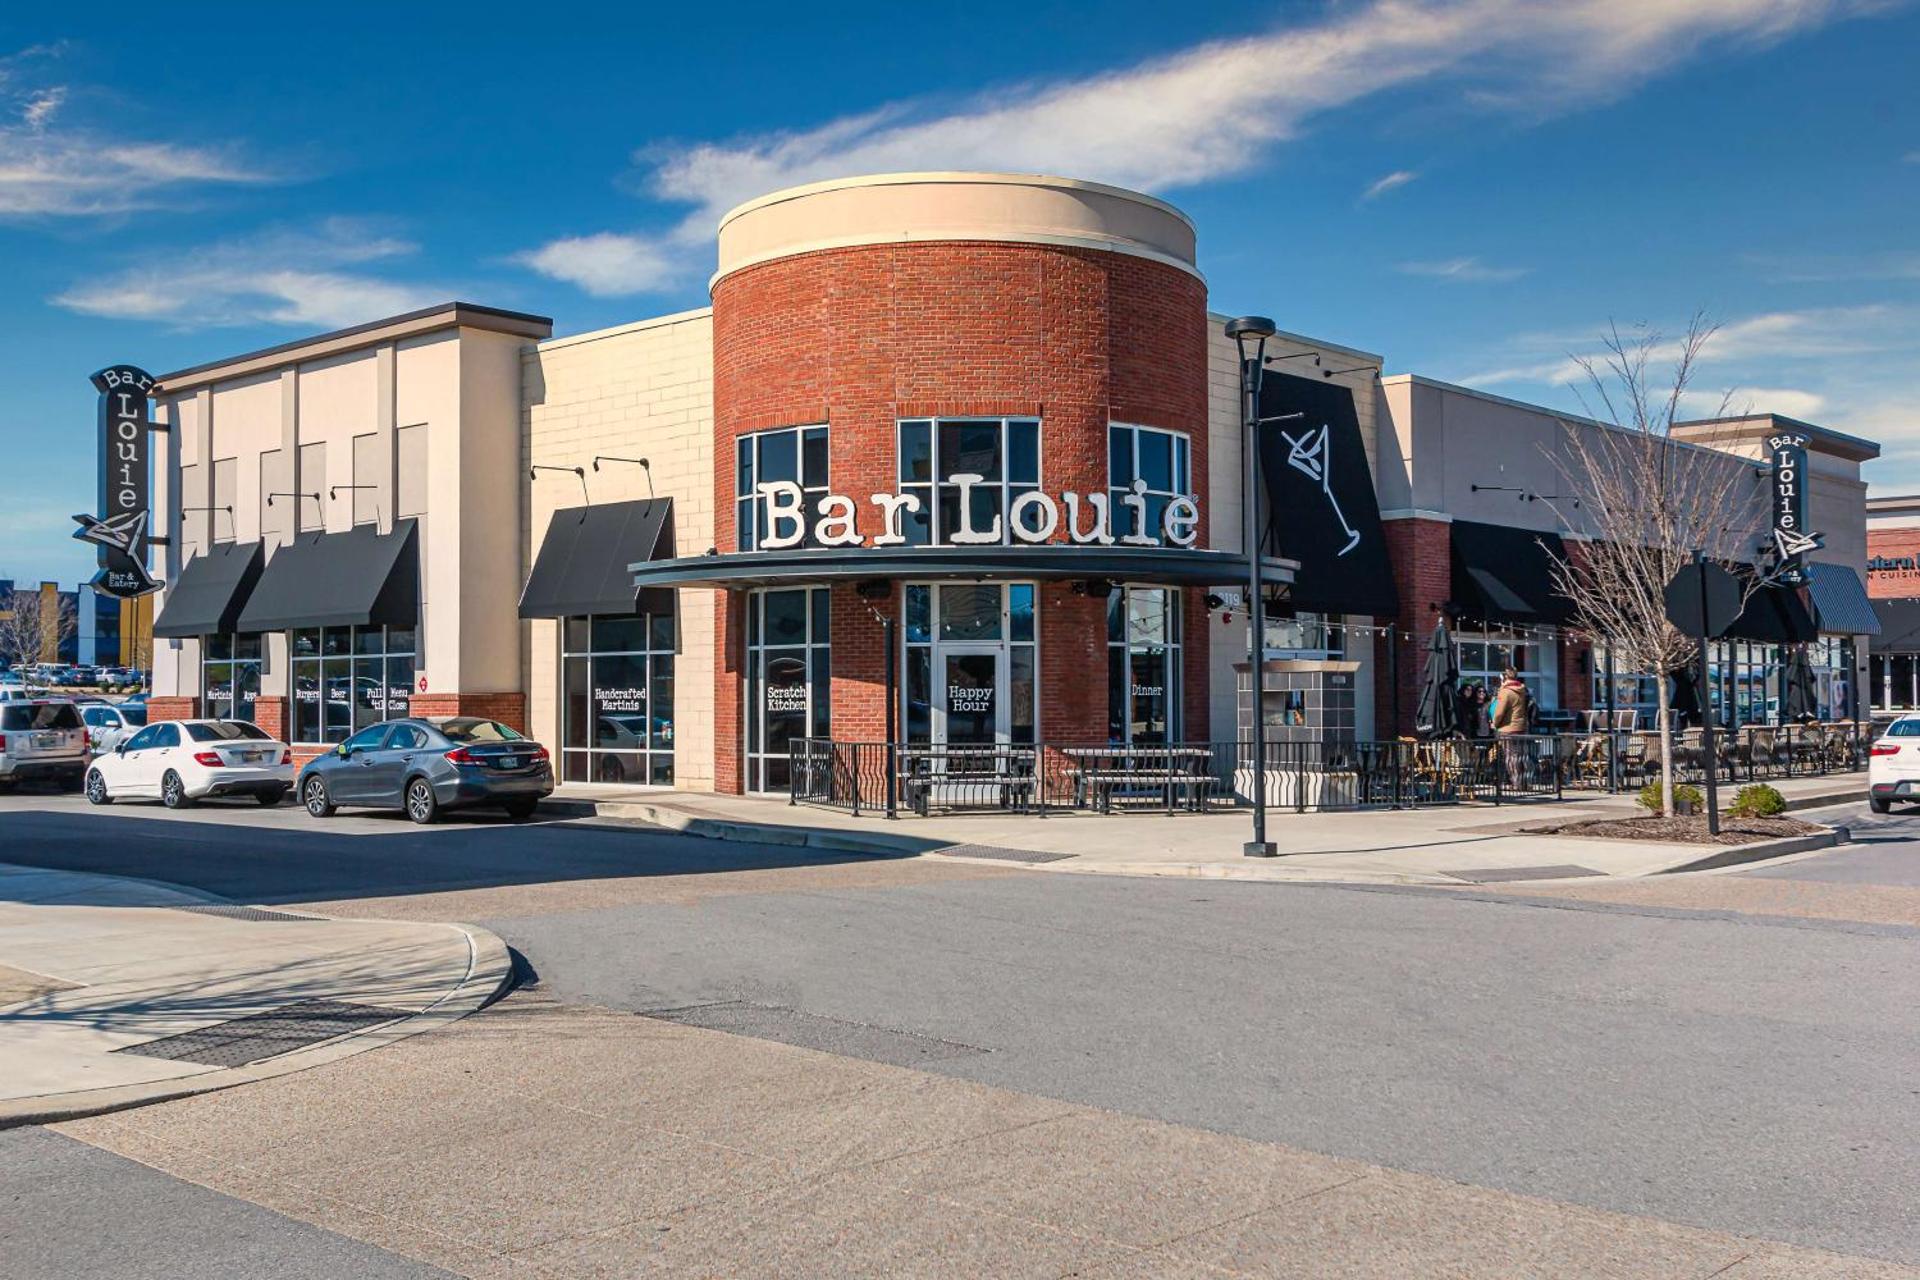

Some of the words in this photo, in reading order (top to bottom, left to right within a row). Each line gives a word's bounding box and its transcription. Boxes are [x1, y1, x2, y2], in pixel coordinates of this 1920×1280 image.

[103, 369, 152, 391] Bar
[1769, 435, 1804, 450] Bar
[116, 393, 138, 508] Louie
[1779, 451, 1795, 528] Louie
[758, 480, 920, 549] Bar
[948, 474, 1200, 546] Louie
[109, 572, 125, 580] Bar
[127, 572, 134, 580] &
[108, 579, 139, 589] Eatery
[330, 688, 346, 699] Beer
[594, 688, 646, 699] Handcrafted
[767, 686, 807, 699] Scratch
[949, 686, 993, 701] Happy
[1131, 684, 1162, 696] Dinner
[388, 699, 408, 710] Close
[602, 700, 639, 710] Martinis
[767, 698, 807, 711] Kitchen
[953, 698, 989, 712] Hour
